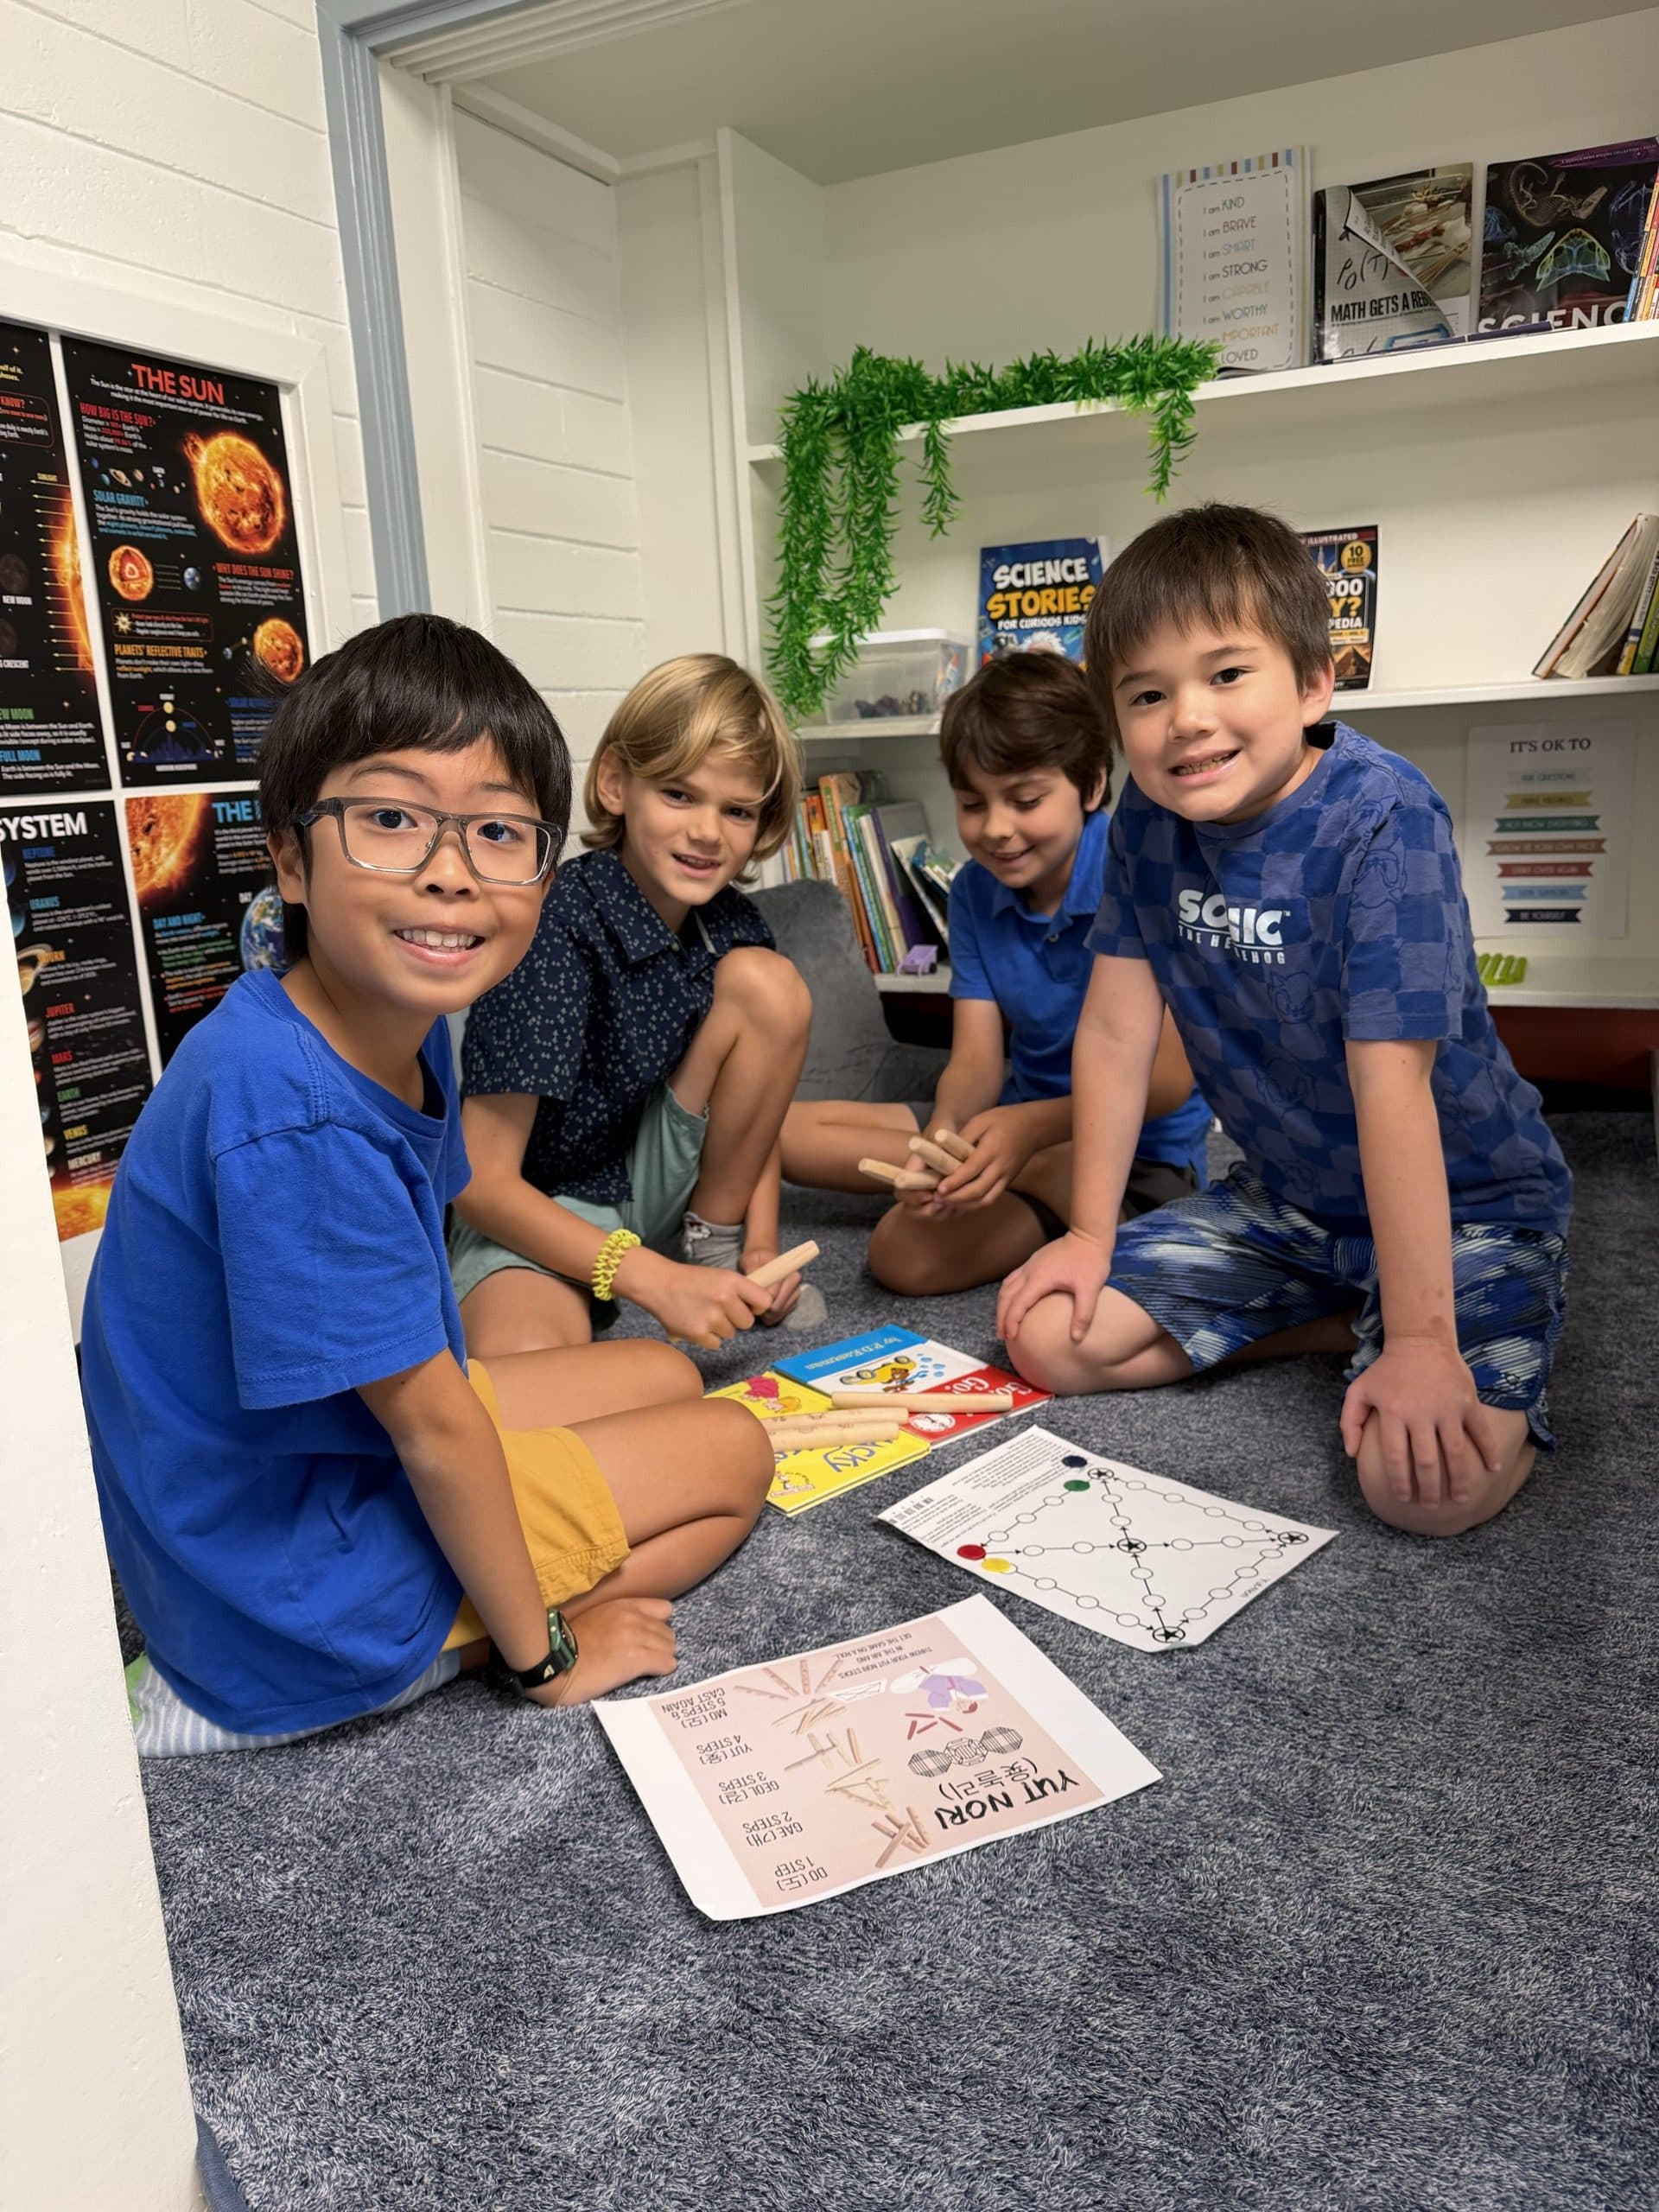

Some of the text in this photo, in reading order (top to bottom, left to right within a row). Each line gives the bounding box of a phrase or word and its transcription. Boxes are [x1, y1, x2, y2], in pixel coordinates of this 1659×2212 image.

[1222, 196, 1244, 210] KIND
[1222, 216, 1257, 233] BRAVE
[1222, 238, 1255, 256] SMART
[1222, 259, 1268, 278] STRONG
[1222, 282, 1270, 301] CAPABLE
[1222, 304, 1268, 322] WORTHY
[1331, 301, 1365, 322] MATH
[1370, 295, 1398, 316] GETS
[1402, 292, 1410, 311] A
[1222, 324, 1280, 342] IMPORTANT
[1221, 349, 1258, 365] LOVED
[131, 363, 176, 394] THE
[178, 375, 225, 406] SUN
[79, 401, 153, 427] HOW BIG IS THE SUN?
[93, 489, 145, 508] SOLAR GRAVITY
[1349, 546, 1363, 557] 10
[216, 562, 294, 581] WHY DOES THE SUN SHINE?
[992, 556, 1090, 589] SCIENCE
[986, 584, 1096, 620] STORIES
[997, 619, 1018, 631] FOR
[1019, 615, 1062, 629] CURIOUS
[145, 644, 182, 658] REFLECTIVE
[182, 646, 204, 658] TRAITS
[0, 707, 10, 720] EW
[1510, 738, 1592, 753] IT'S OK TO
[213, 800, 254, 823] THE
[29, 895, 60, 911] URANUS
[238, 892, 252, 904] DAY
[1179, 888, 1283, 945] SONIC
[1178, 925, 1286, 964] THE HEEHOG
[45, 1002, 75, 1019] JUPITER
[51, 1051, 74, 1065] MARS
[56, 1086, 81, 1103] EARTH
[62, 1124, 88, 1141] VENUS
[67, 1151, 102, 1171] MERCURY
[662, 1687, 726, 1713] CAST AGAIN
[681, 1699, 716, 1717] STEPS
[716, 1697, 726, 1707] 5
[709, 1707, 728, 1721] MO
[696, 1734, 742, 1754] 4 STEPS
[729, 1743, 753, 1758] YUT
[719, 1770, 767, 1792] 3 STEPS
[748, 1779, 779, 1797] GEOL
[934, 1770, 1080, 1830] YUT NORI
[741, 1811, 792, 1834] 2 STEPS
[776, 1821, 804, 1839] GAE
[774, 1855, 815, 1878] 1 STEP
[809, 1866, 828, 1882] DO
